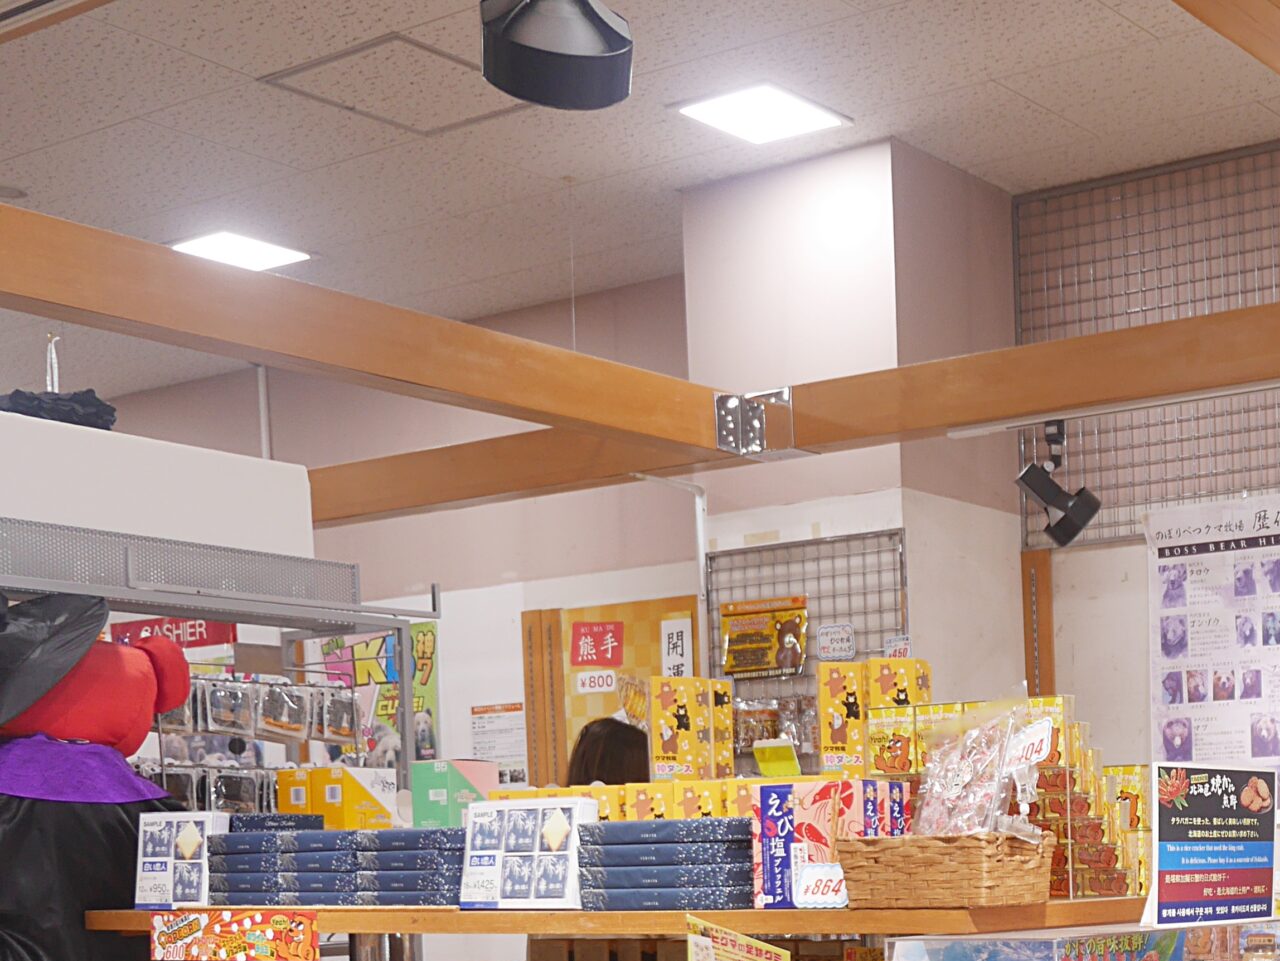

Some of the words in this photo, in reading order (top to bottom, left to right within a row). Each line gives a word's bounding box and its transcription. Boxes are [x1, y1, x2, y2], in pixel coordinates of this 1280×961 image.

[1164, 546, 1198, 557] BOSS
[1209, 540, 1248, 552] BEAR
[578, 632, 619, 661] 熊手
[667, 630, 686, 677] 開運
[580, 674, 614, 689] ¥800
[764, 792, 794, 858] えび塩
[803, 878, 844, 897] ¥864
[166, 944, 185, 960] 600
[1064, 933, 1150, 957] かにの旨味抜群!
